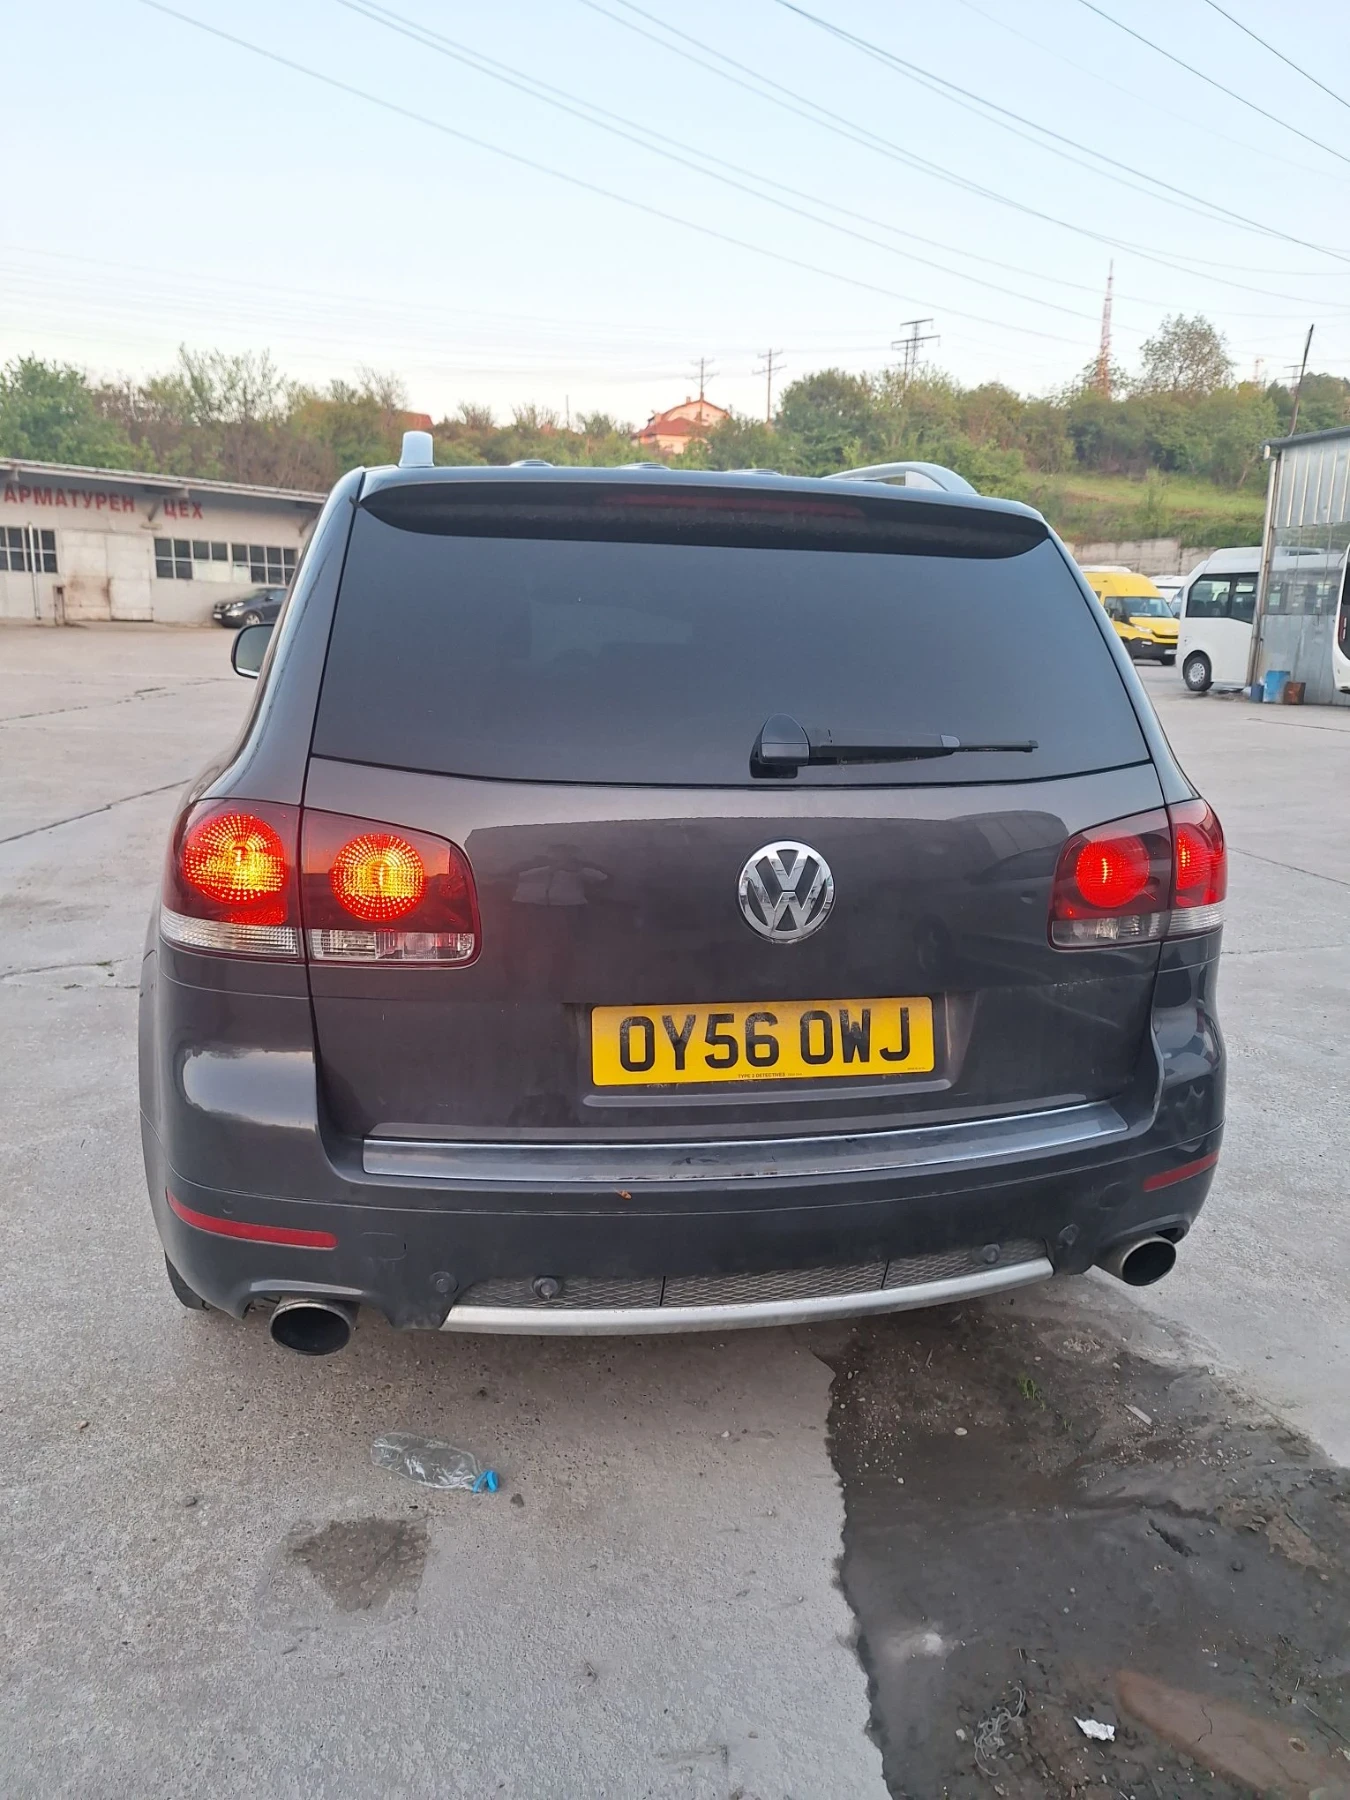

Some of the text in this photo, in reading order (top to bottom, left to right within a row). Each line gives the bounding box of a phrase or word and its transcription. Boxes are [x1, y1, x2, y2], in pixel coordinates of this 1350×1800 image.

[3, 484, 204, 520] АРМАТУРЕН ЦЕХ
[619, 1006, 911, 1072] OY56 OWJ
